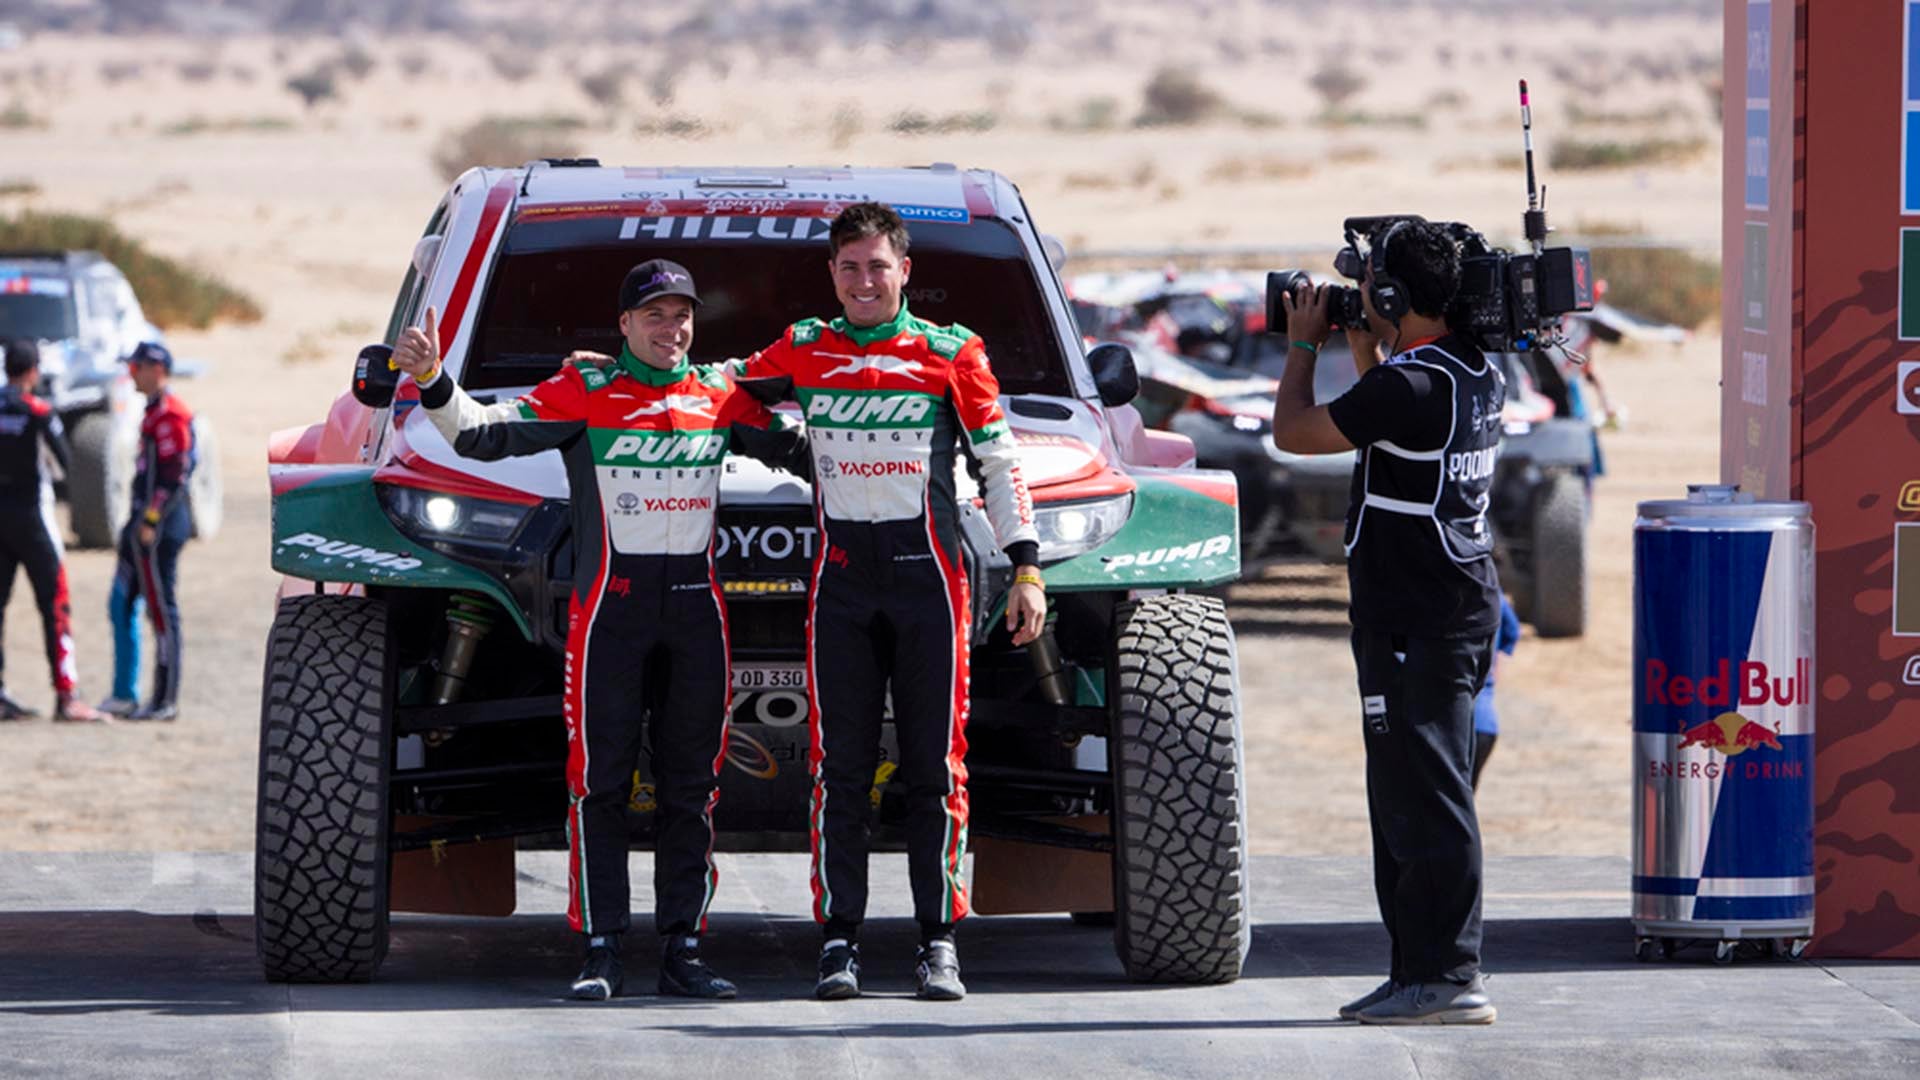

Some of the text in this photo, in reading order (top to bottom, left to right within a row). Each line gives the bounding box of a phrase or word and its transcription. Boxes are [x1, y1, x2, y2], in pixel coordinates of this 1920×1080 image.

[696, 190, 870, 200] YACOPINI
[894, 205, 963, 219] ramco
[806, 393, 931, 424] PUMA
[811, 429, 923, 443] ENERGY
[604, 434, 725, 463] PUMA
[611, 469, 715, 480] ENERGY
[838, 460, 923, 478] YACOPINI
[643, 497, 712, 512] YACOPINI
[280, 532, 423, 571] PUMA
[1103, 534, 1232, 573] PUMA
[276, 547, 397, 578] ENERGY
[769, 671, 804, 686] 330
[1644, 657, 1810, 706] Red Bull
[1650, 761, 1804, 780] ENERGY DRINK
